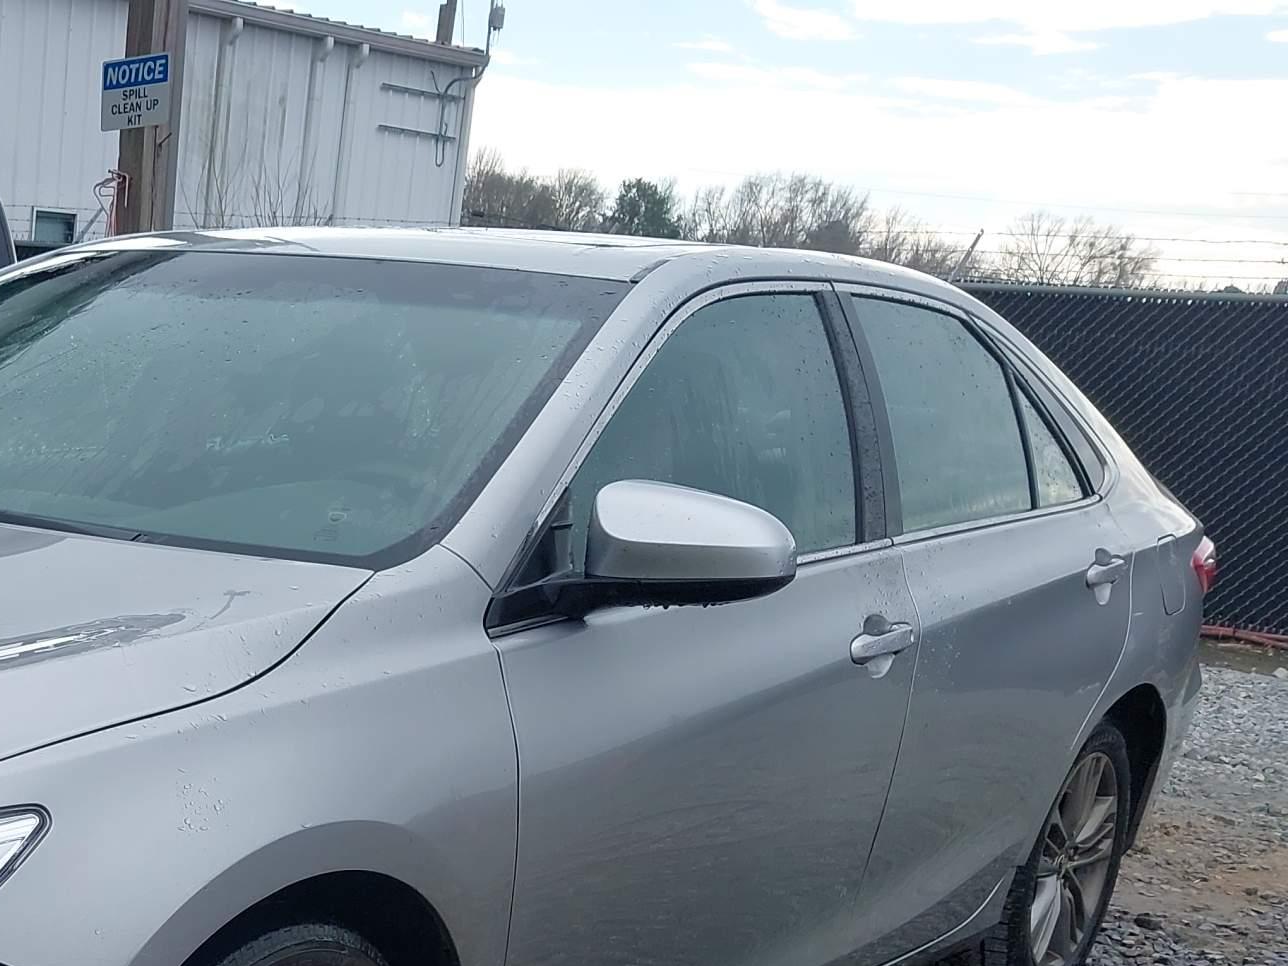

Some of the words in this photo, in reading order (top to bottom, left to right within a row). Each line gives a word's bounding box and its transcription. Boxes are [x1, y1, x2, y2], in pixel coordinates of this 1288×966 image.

[106, 60, 166, 87] NOTICE
[122, 87, 148, 101] SPILL
[111, 101, 142, 115] CLEAN
[146, 99, 159, 111] UP
[127, 114, 142, 127] KIT
